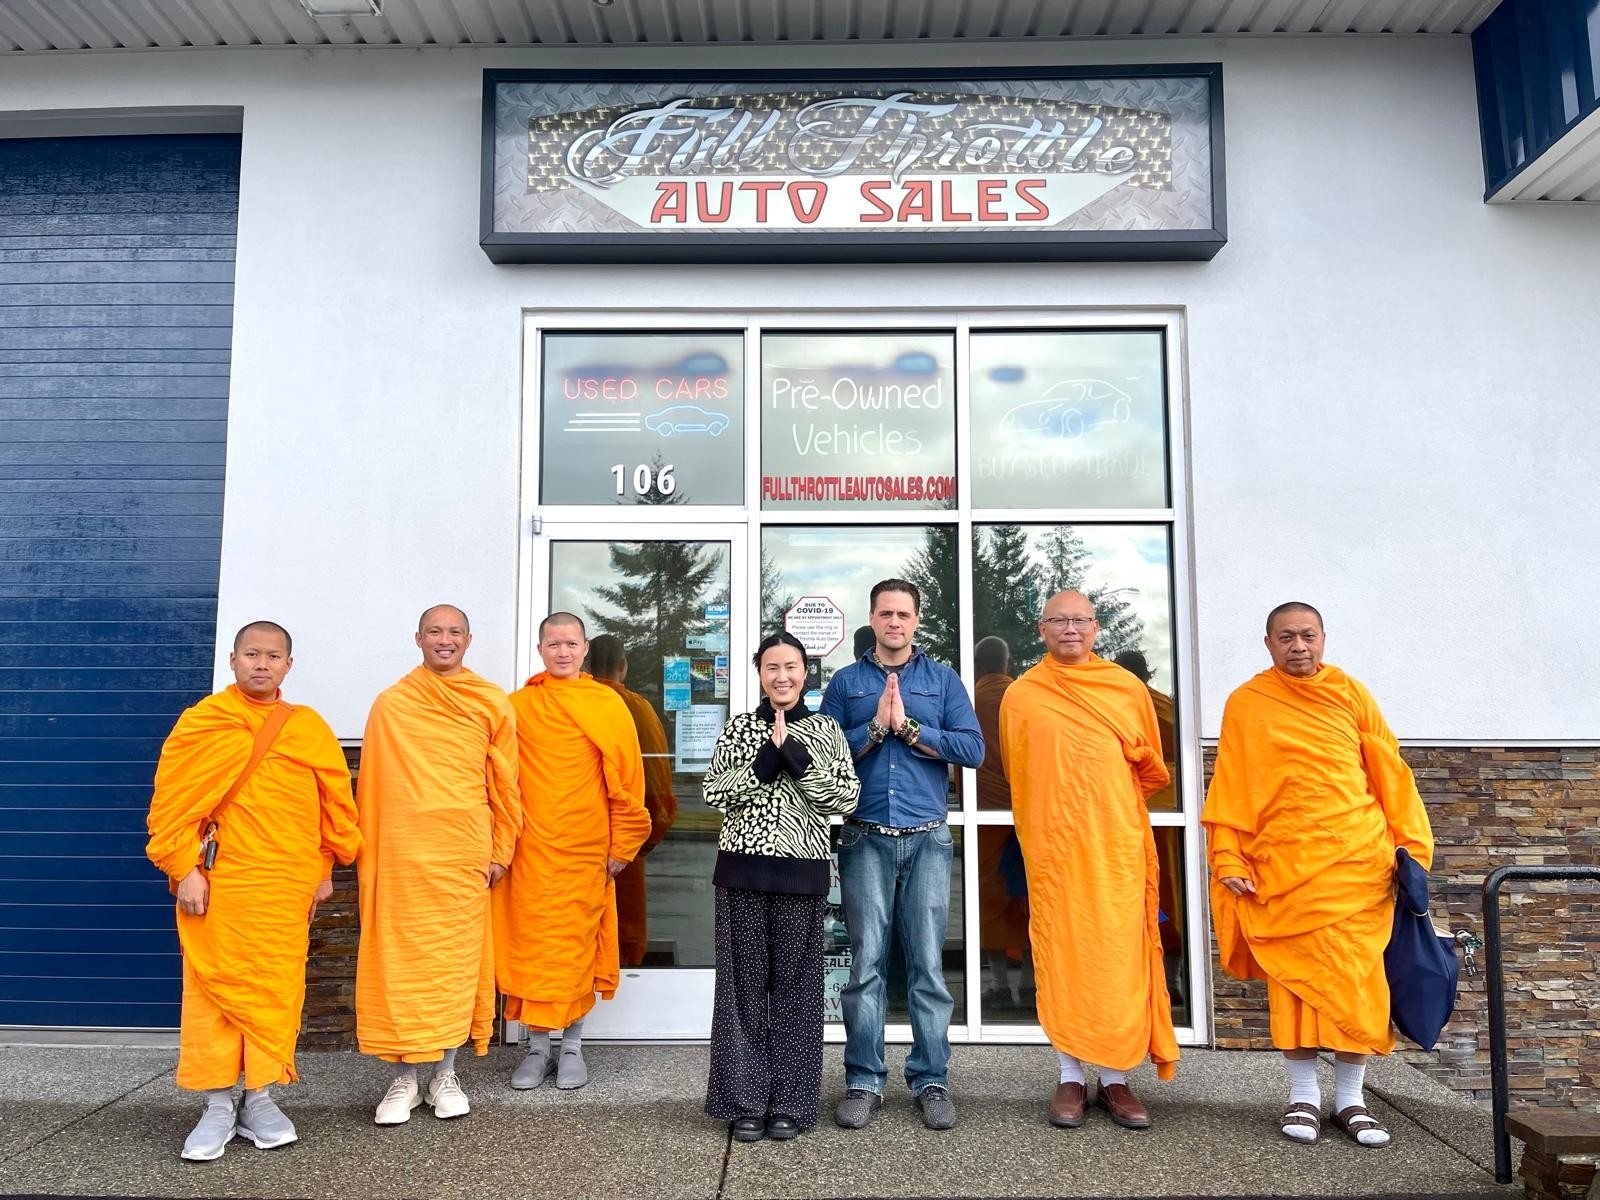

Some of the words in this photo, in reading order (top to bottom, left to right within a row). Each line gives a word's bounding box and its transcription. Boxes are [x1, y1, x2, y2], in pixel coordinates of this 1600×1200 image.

[567, 99, 782, 187] Full
[791, 92, 1139, 184] Throttle
[650, 181, 829, 224] AUTO
[860, 179, 1050, 223] SALES
[563, 377, 639, 400] USED
[655, 377, 729, 400] CARS
[772, 377, 943, 410] Pre-Owned
[792, 422, 922, 456] Vehicles
[610, 463, 676, 496] 106
[762, 476, 956, 501] FULLTHROTTLEAUTOSALES.COM
[667, 700, 688, 708] 2020
